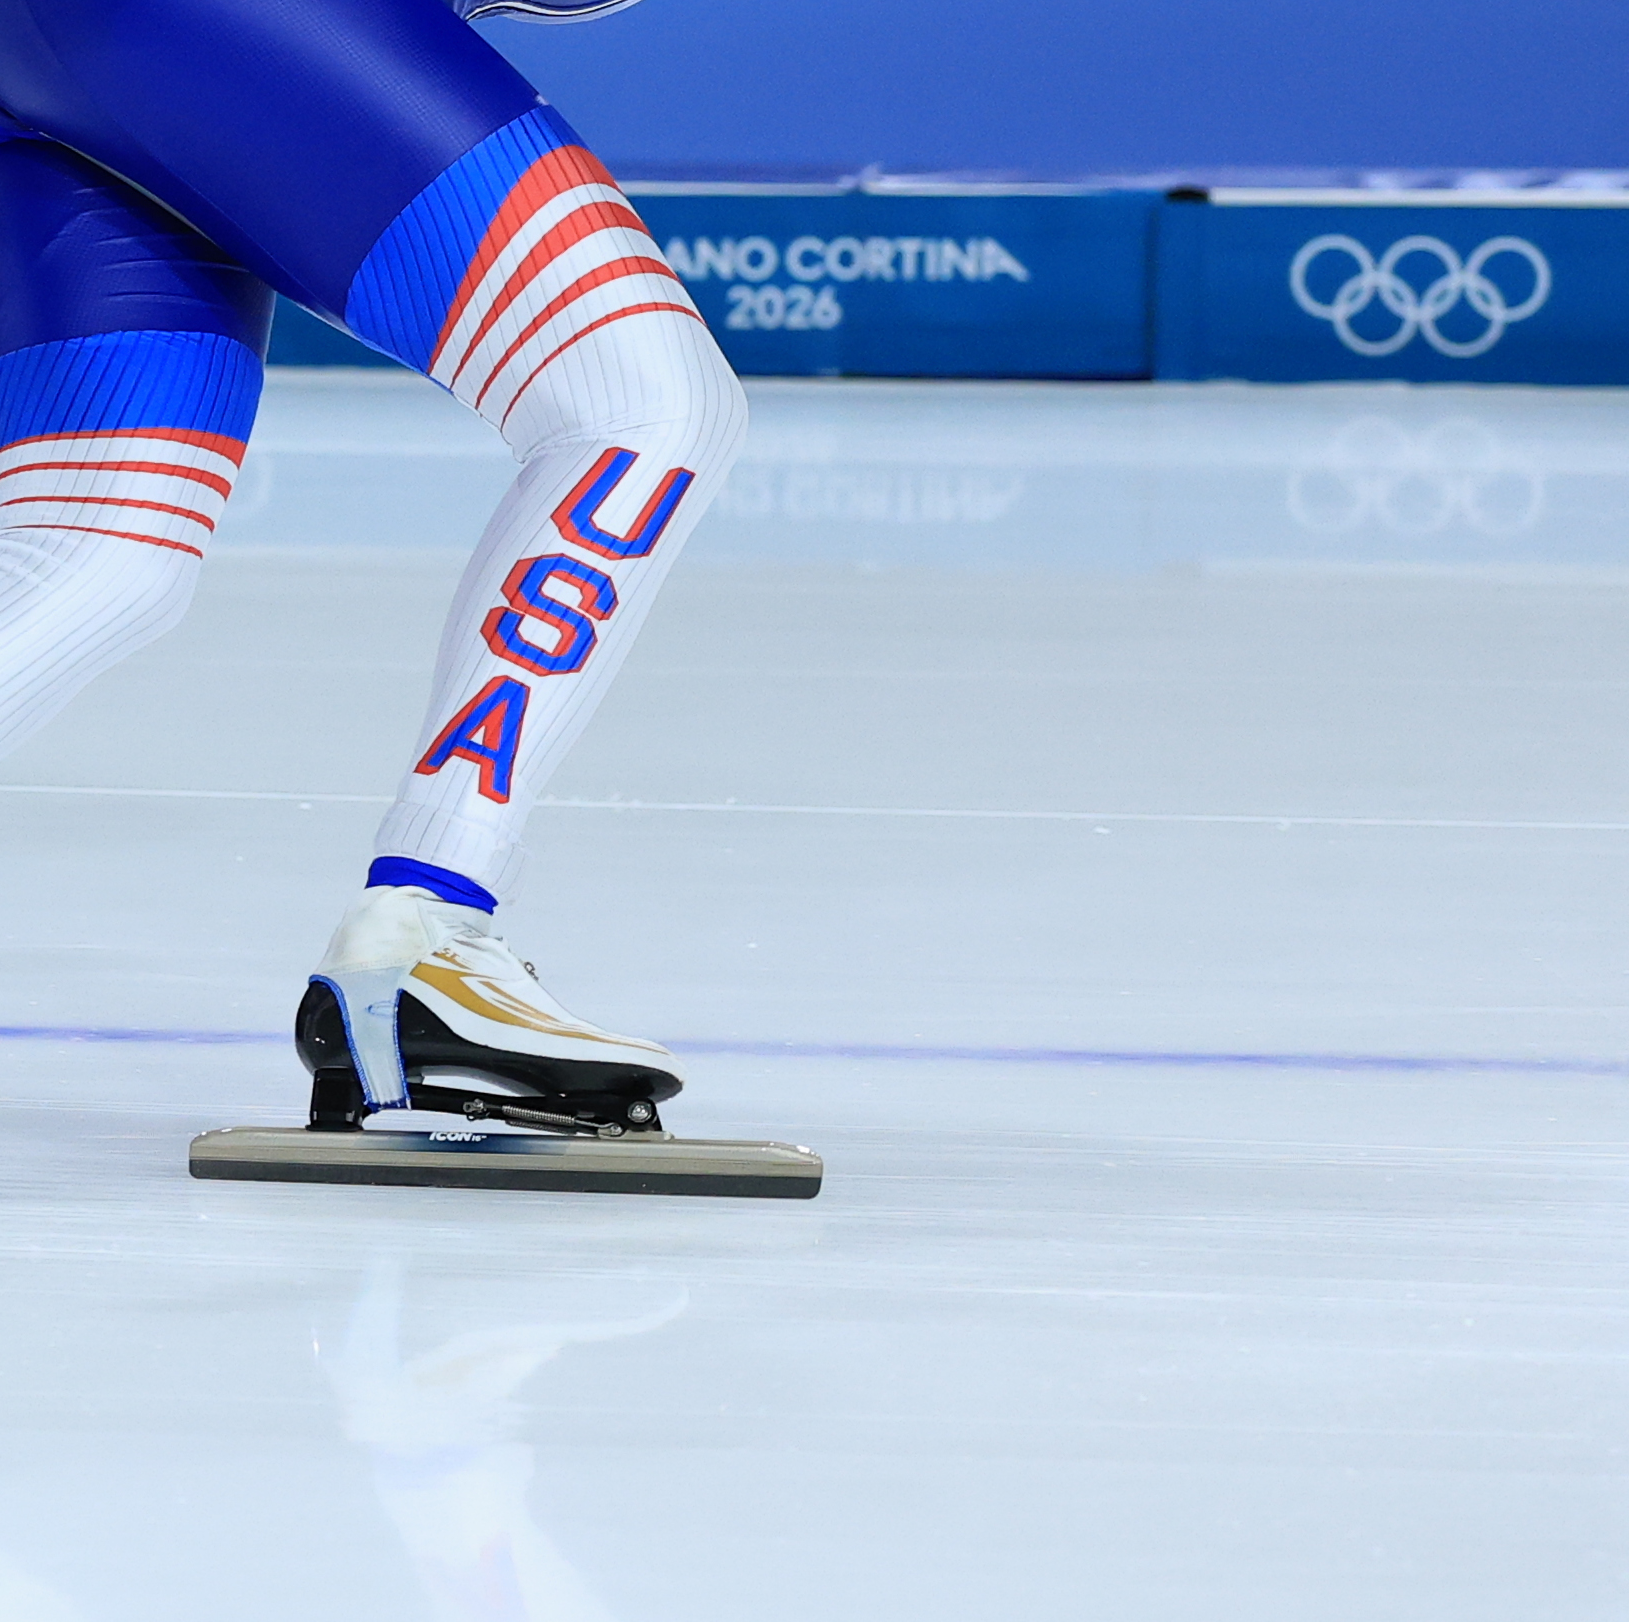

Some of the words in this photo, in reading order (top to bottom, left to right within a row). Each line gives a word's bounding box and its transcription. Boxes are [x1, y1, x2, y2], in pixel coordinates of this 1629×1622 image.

[784, 235, 1031, 283] CORTINA
[724, 284, 842, 330] 2026
[413, 446, 697, 805] USA
[428, 1131, 472, 1142] ICON
